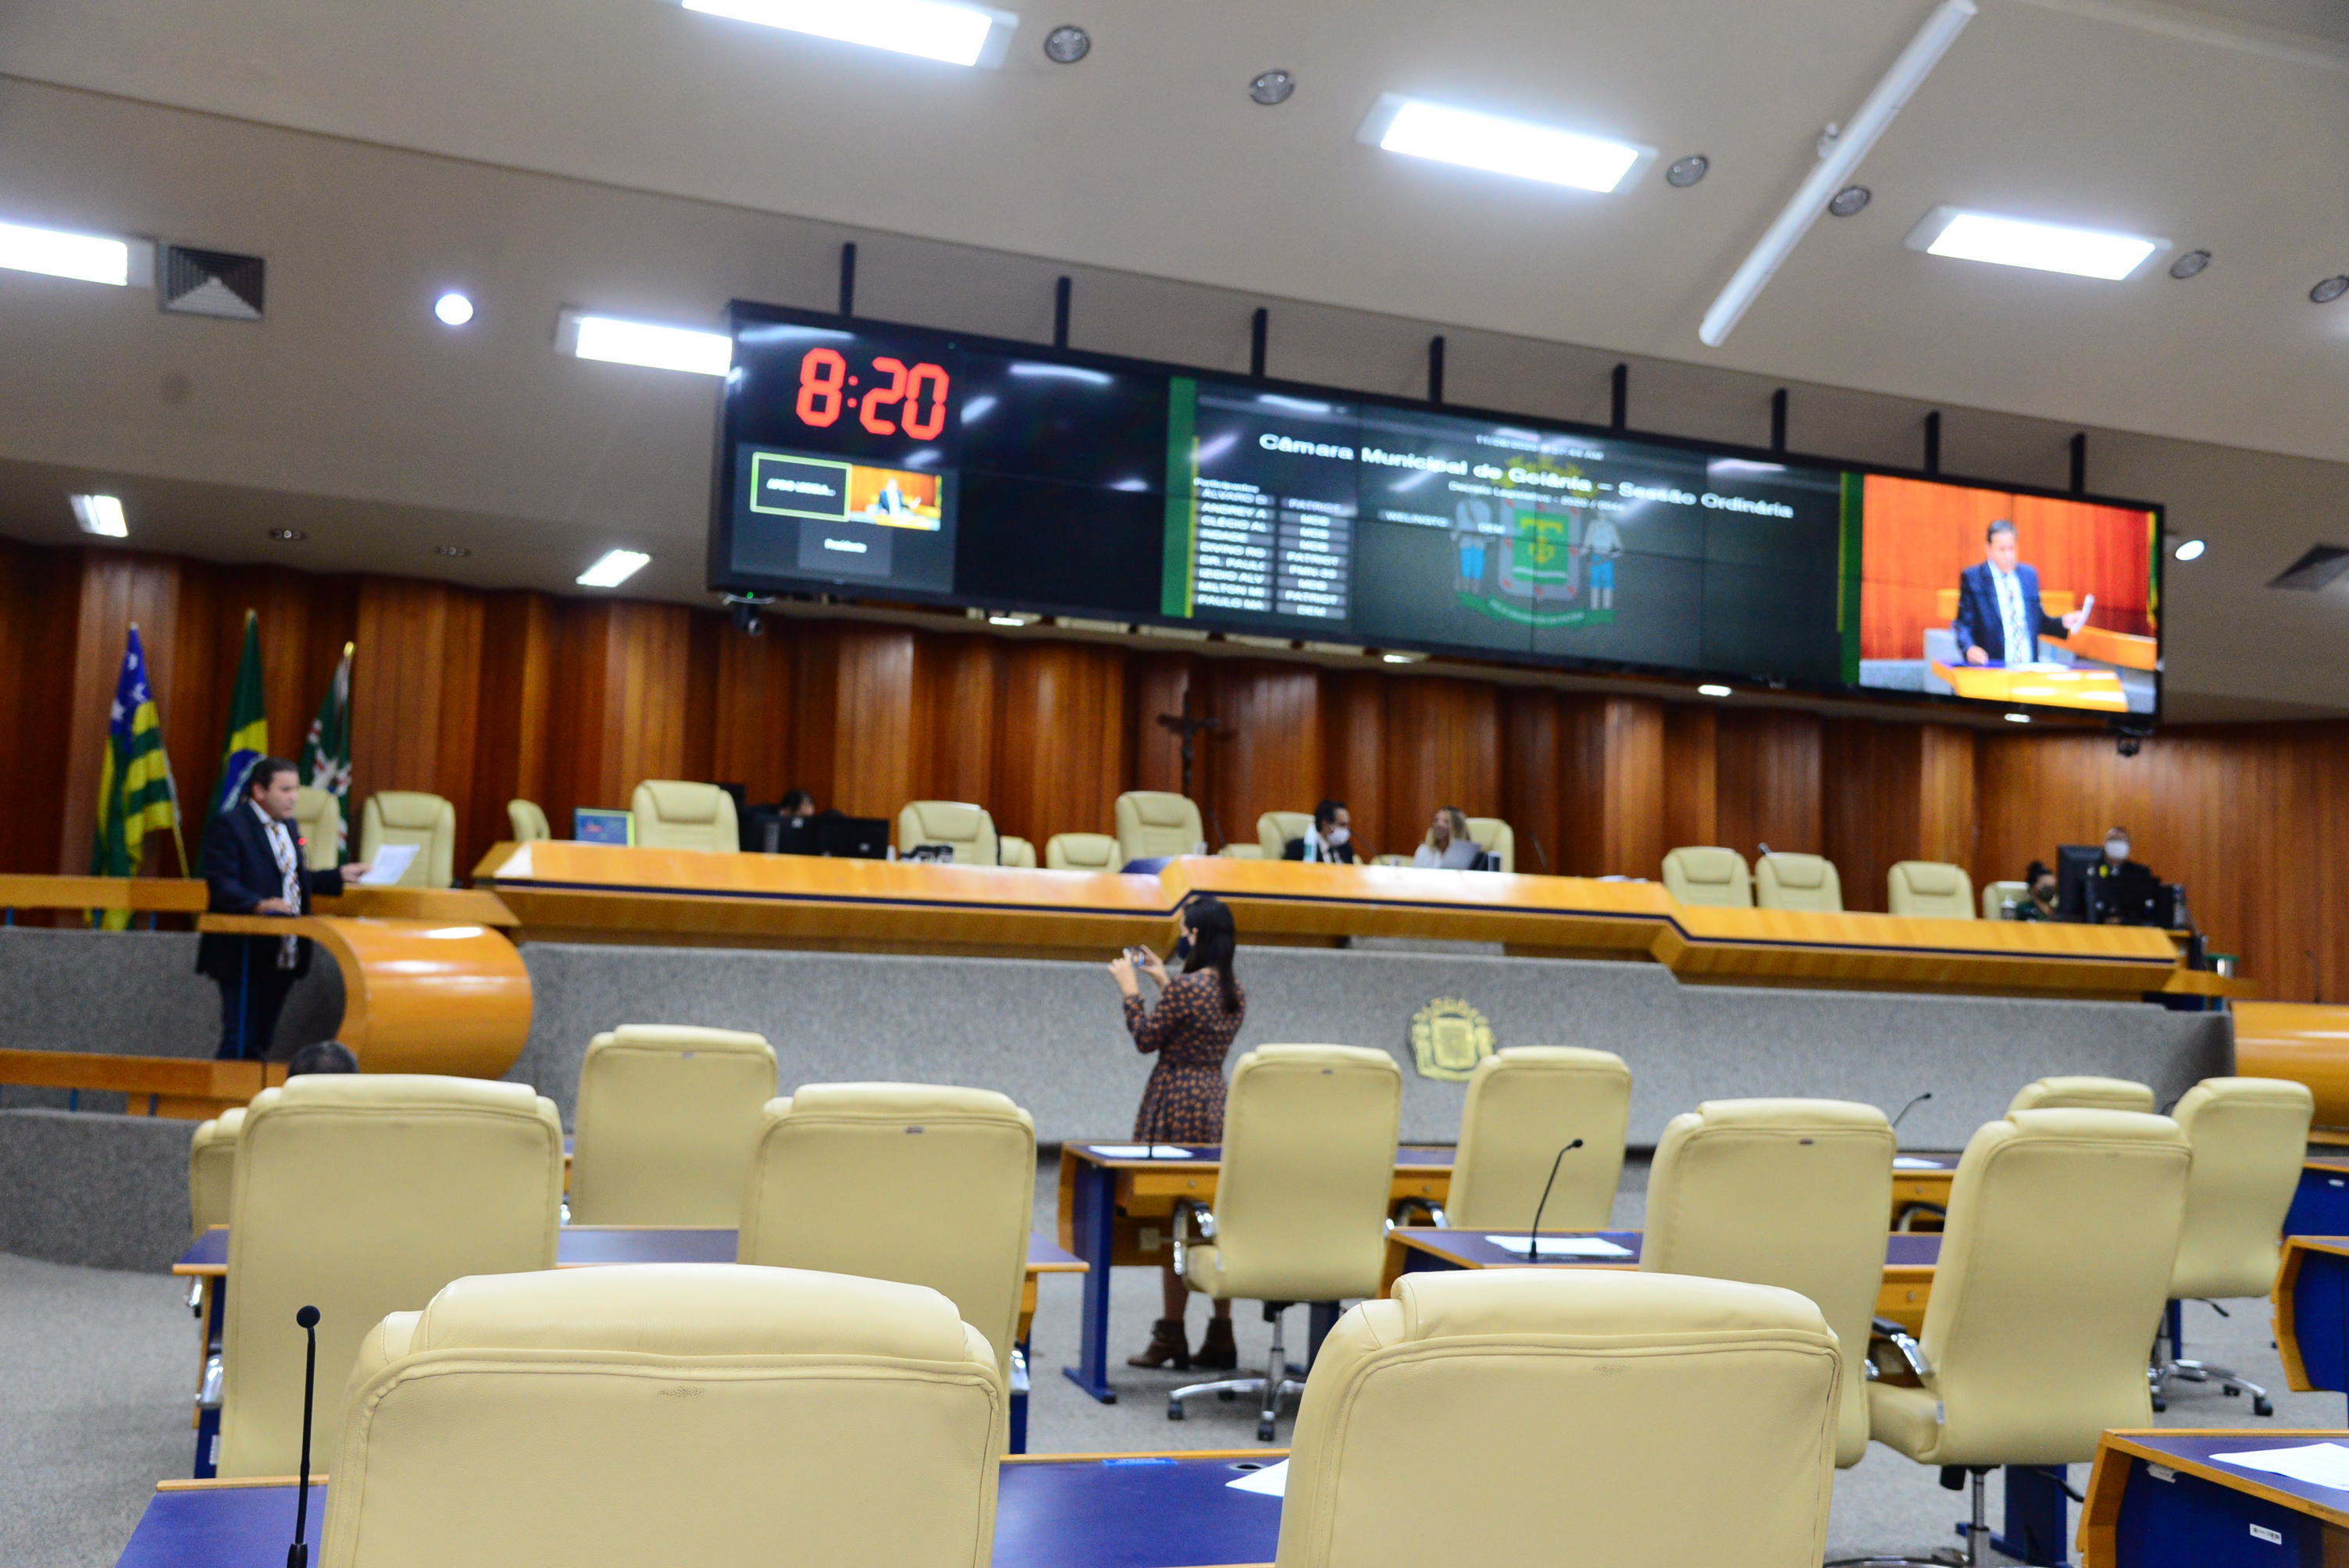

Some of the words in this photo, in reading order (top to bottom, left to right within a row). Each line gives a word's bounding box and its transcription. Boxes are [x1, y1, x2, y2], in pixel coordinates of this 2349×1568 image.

[796, 347, 950, 440] 8:20
[1259, 433, 1354, 461] Câmara
[1361, 447, 1467, 477] Municipal
[1473, 462, 1502, 480] de
[1508, 466, 1592, 493] Goiânia
[1618, 482, 1697, 505] Sessão
[1700, 491, 1795, 519] Ordinária
[1477, 522, 1506, 535] DEM
